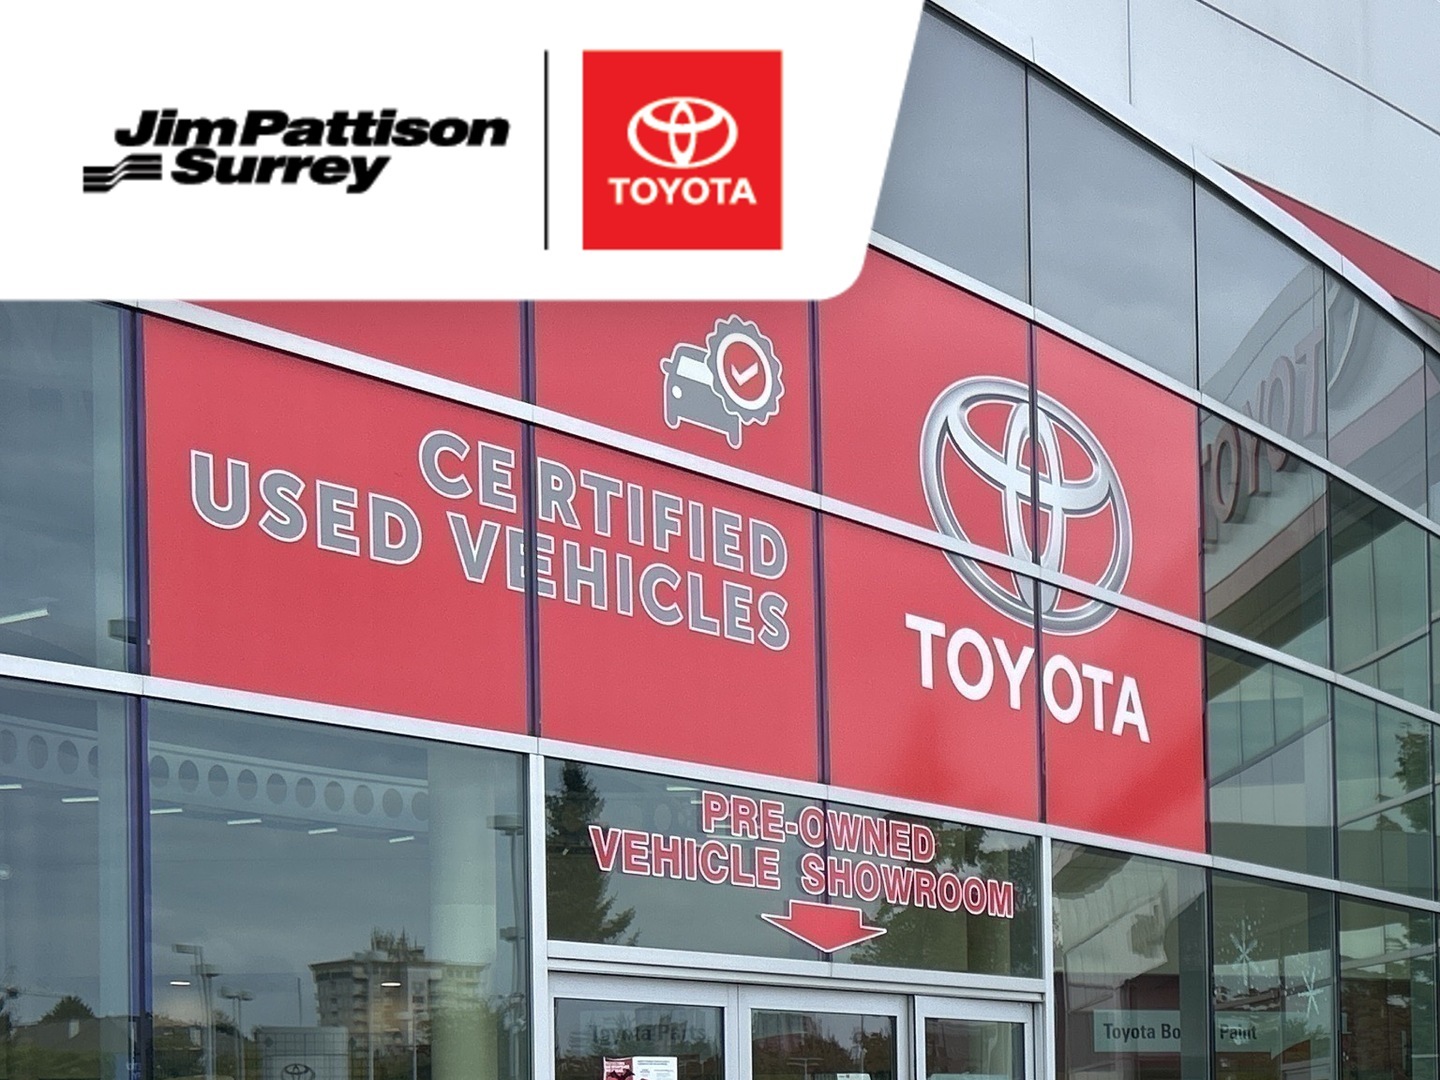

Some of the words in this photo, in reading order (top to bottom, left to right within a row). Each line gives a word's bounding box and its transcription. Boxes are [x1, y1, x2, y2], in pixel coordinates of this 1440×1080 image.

[190, 449, 423, 565] USED
[445, 510, 791, 651] VEHICLES
[418, 429, 789, 580] CERTIFIED
[905, 613, 1151, 744] TOYOTA
[588, 825, 781, 891] VEHICLE
[800, 853, 1015, 918] SHOWROOM
[701, 790, 937, 864] PRE-OWNED
[1103, 1023, 1156, 1043] Toyota
[1161, 1024, 1181, 1040] Bo
[1220, 1023, 1257, 1040] Paint
